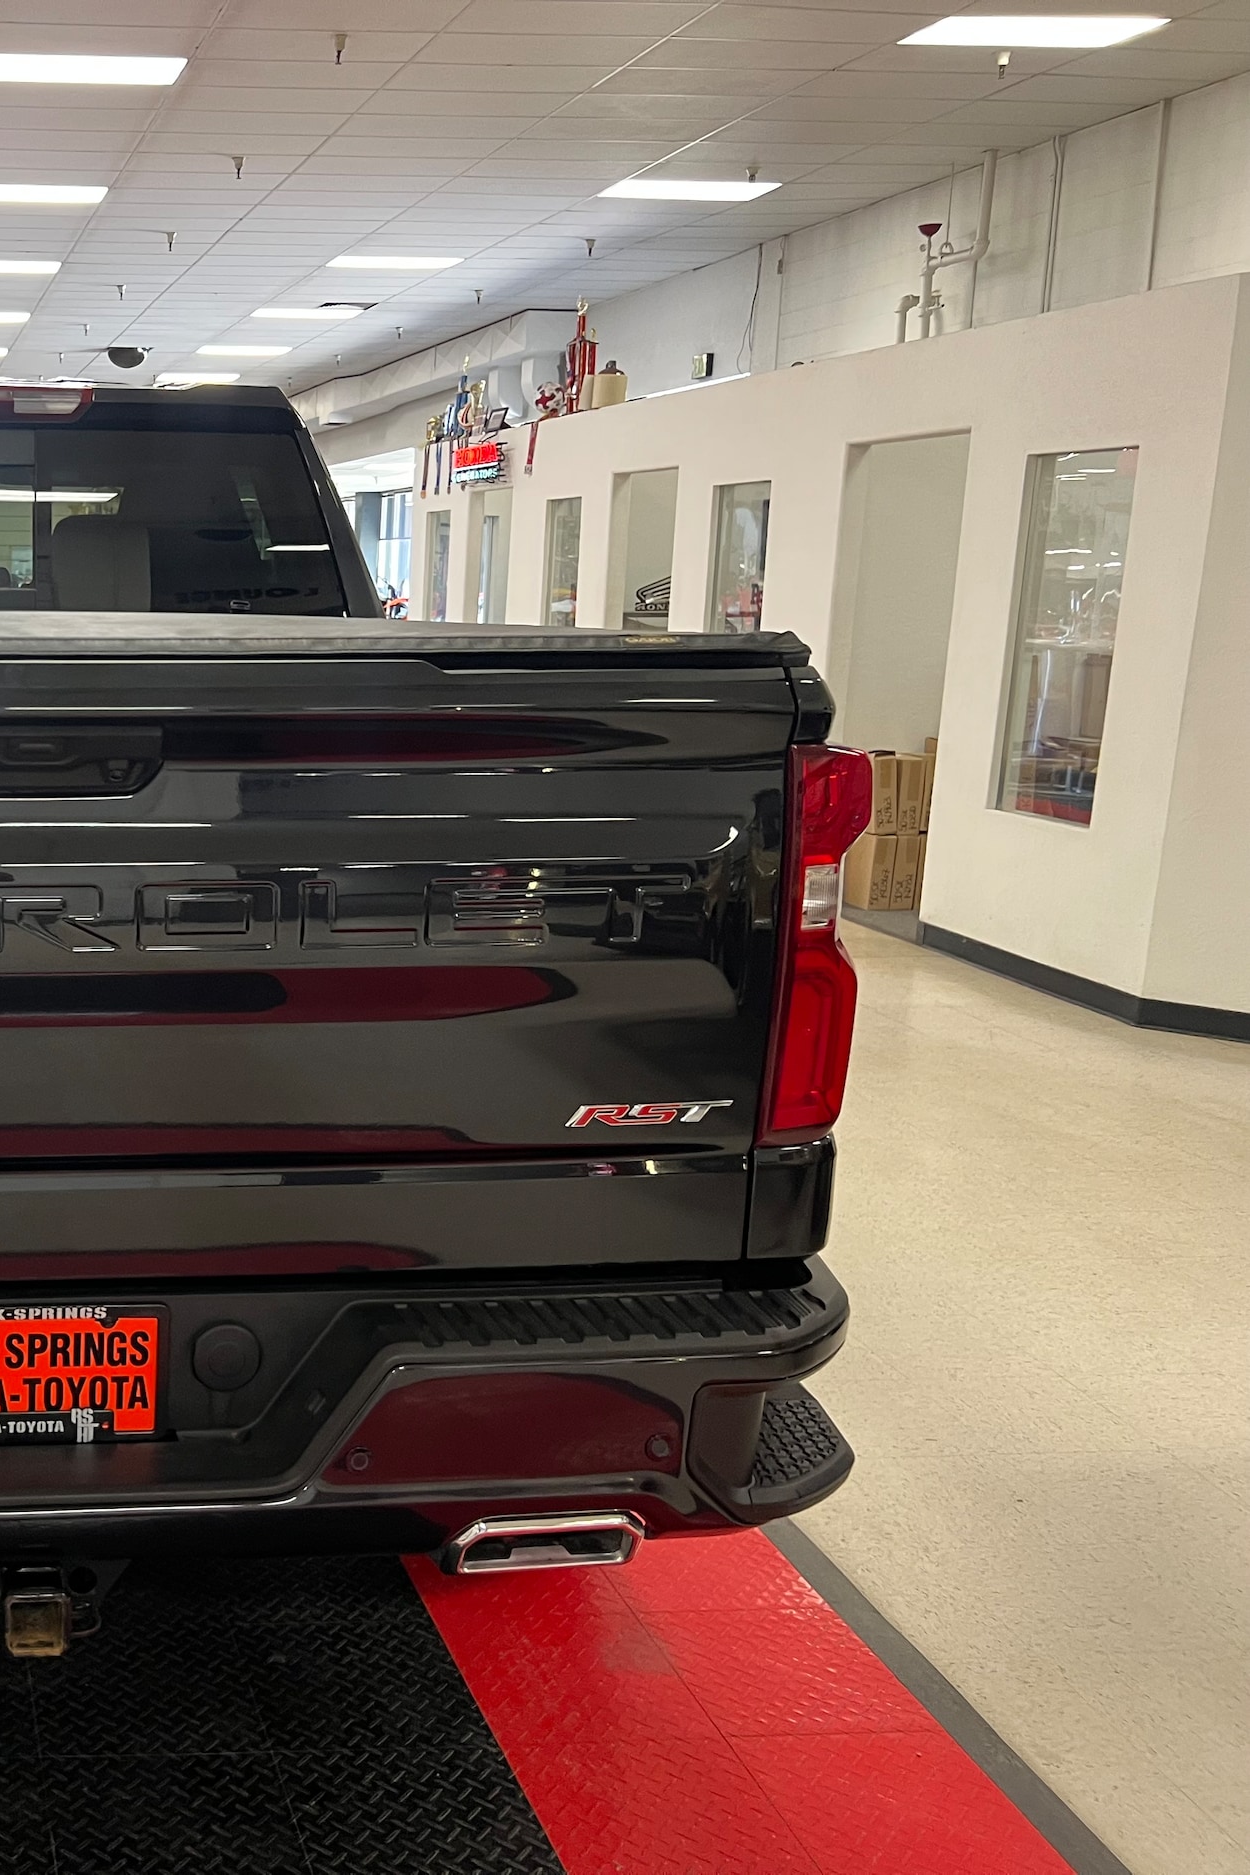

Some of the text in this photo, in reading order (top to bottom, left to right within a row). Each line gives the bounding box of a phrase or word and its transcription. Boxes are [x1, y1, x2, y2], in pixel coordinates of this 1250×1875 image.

[455, 443, 498, 468] HONDA
[565, 1099, 734, 1128] RST
[4, 1331, 150, 1369] SPRINGS
